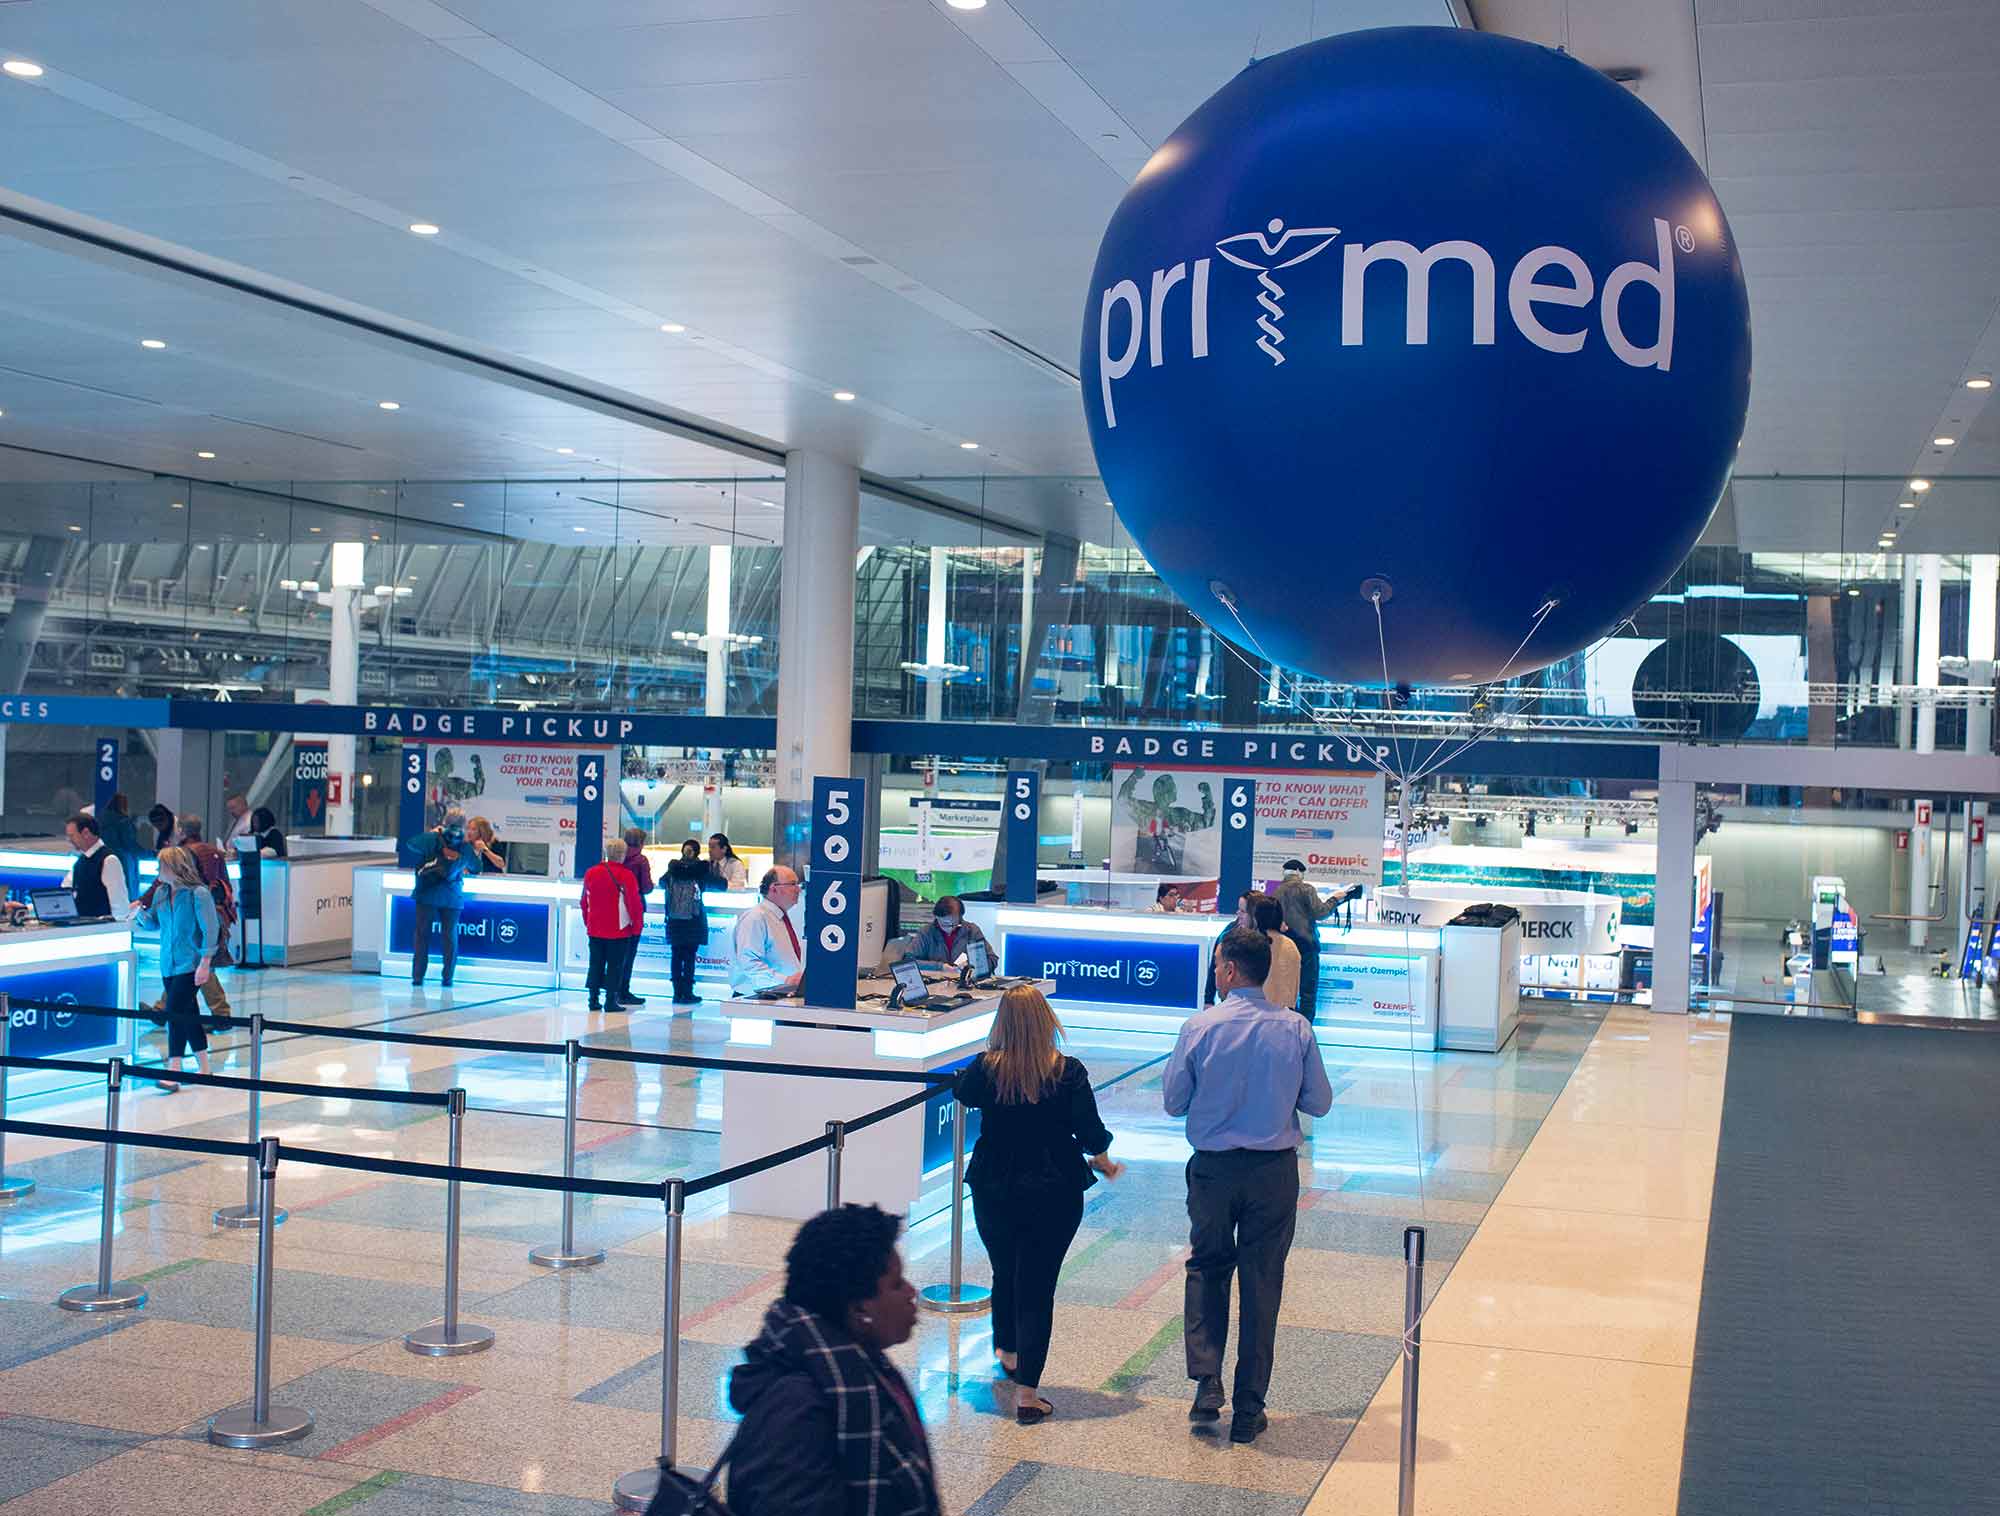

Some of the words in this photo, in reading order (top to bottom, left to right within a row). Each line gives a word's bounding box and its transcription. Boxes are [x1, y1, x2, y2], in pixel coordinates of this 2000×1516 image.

[2, 702, 48, 717] CES
[365, 712, 475, 733] BADGE
[502, 716, 633, 738] PICKUP
[102, 744, 113, 762] 2
[1091, 736, 1214, 758] BADGE
[1245, 741, 1390, 763] PICKUP
[408, 754, 421, 773] 3
[504, 753, 524, 763] GET
[526, 754, 538, 764] TO
[541, 755, 574, 765] KNOW
[296, 766, 328, 780] COUR
[552, 767, 574, 776] CAN
[584, 761, 598, 781] 4
[516, 777, 543, 787] YOUR
[545, 778, 579, 788] PATIEN
[1016, 778, 1030, 798] 5
[1267, 782, 1281, 792] TO
[1285, 783, 1325, 794] KNOW
[1329, 785, 1367, 795] WHAT
[1231, 786, 1247, 807] 6
[1297, 797, 1326, 807] CAN
[1330, 798, 1369, 808] OFFER
[825, 791, 849, 825] 5
[1254, 807, 1287, 818] YOUR
[1291, 809, 1349, 821] PATIENTS
[940, 813, 989, 823] Marketplace
[822, 880, 847, 915] 6
[500, 925, 515, 937] 25
[1138, 967, 1155, 979] 25
[1342, 964, 1368, 974] about
[1370, 966, 1409, 976] Ozempic
